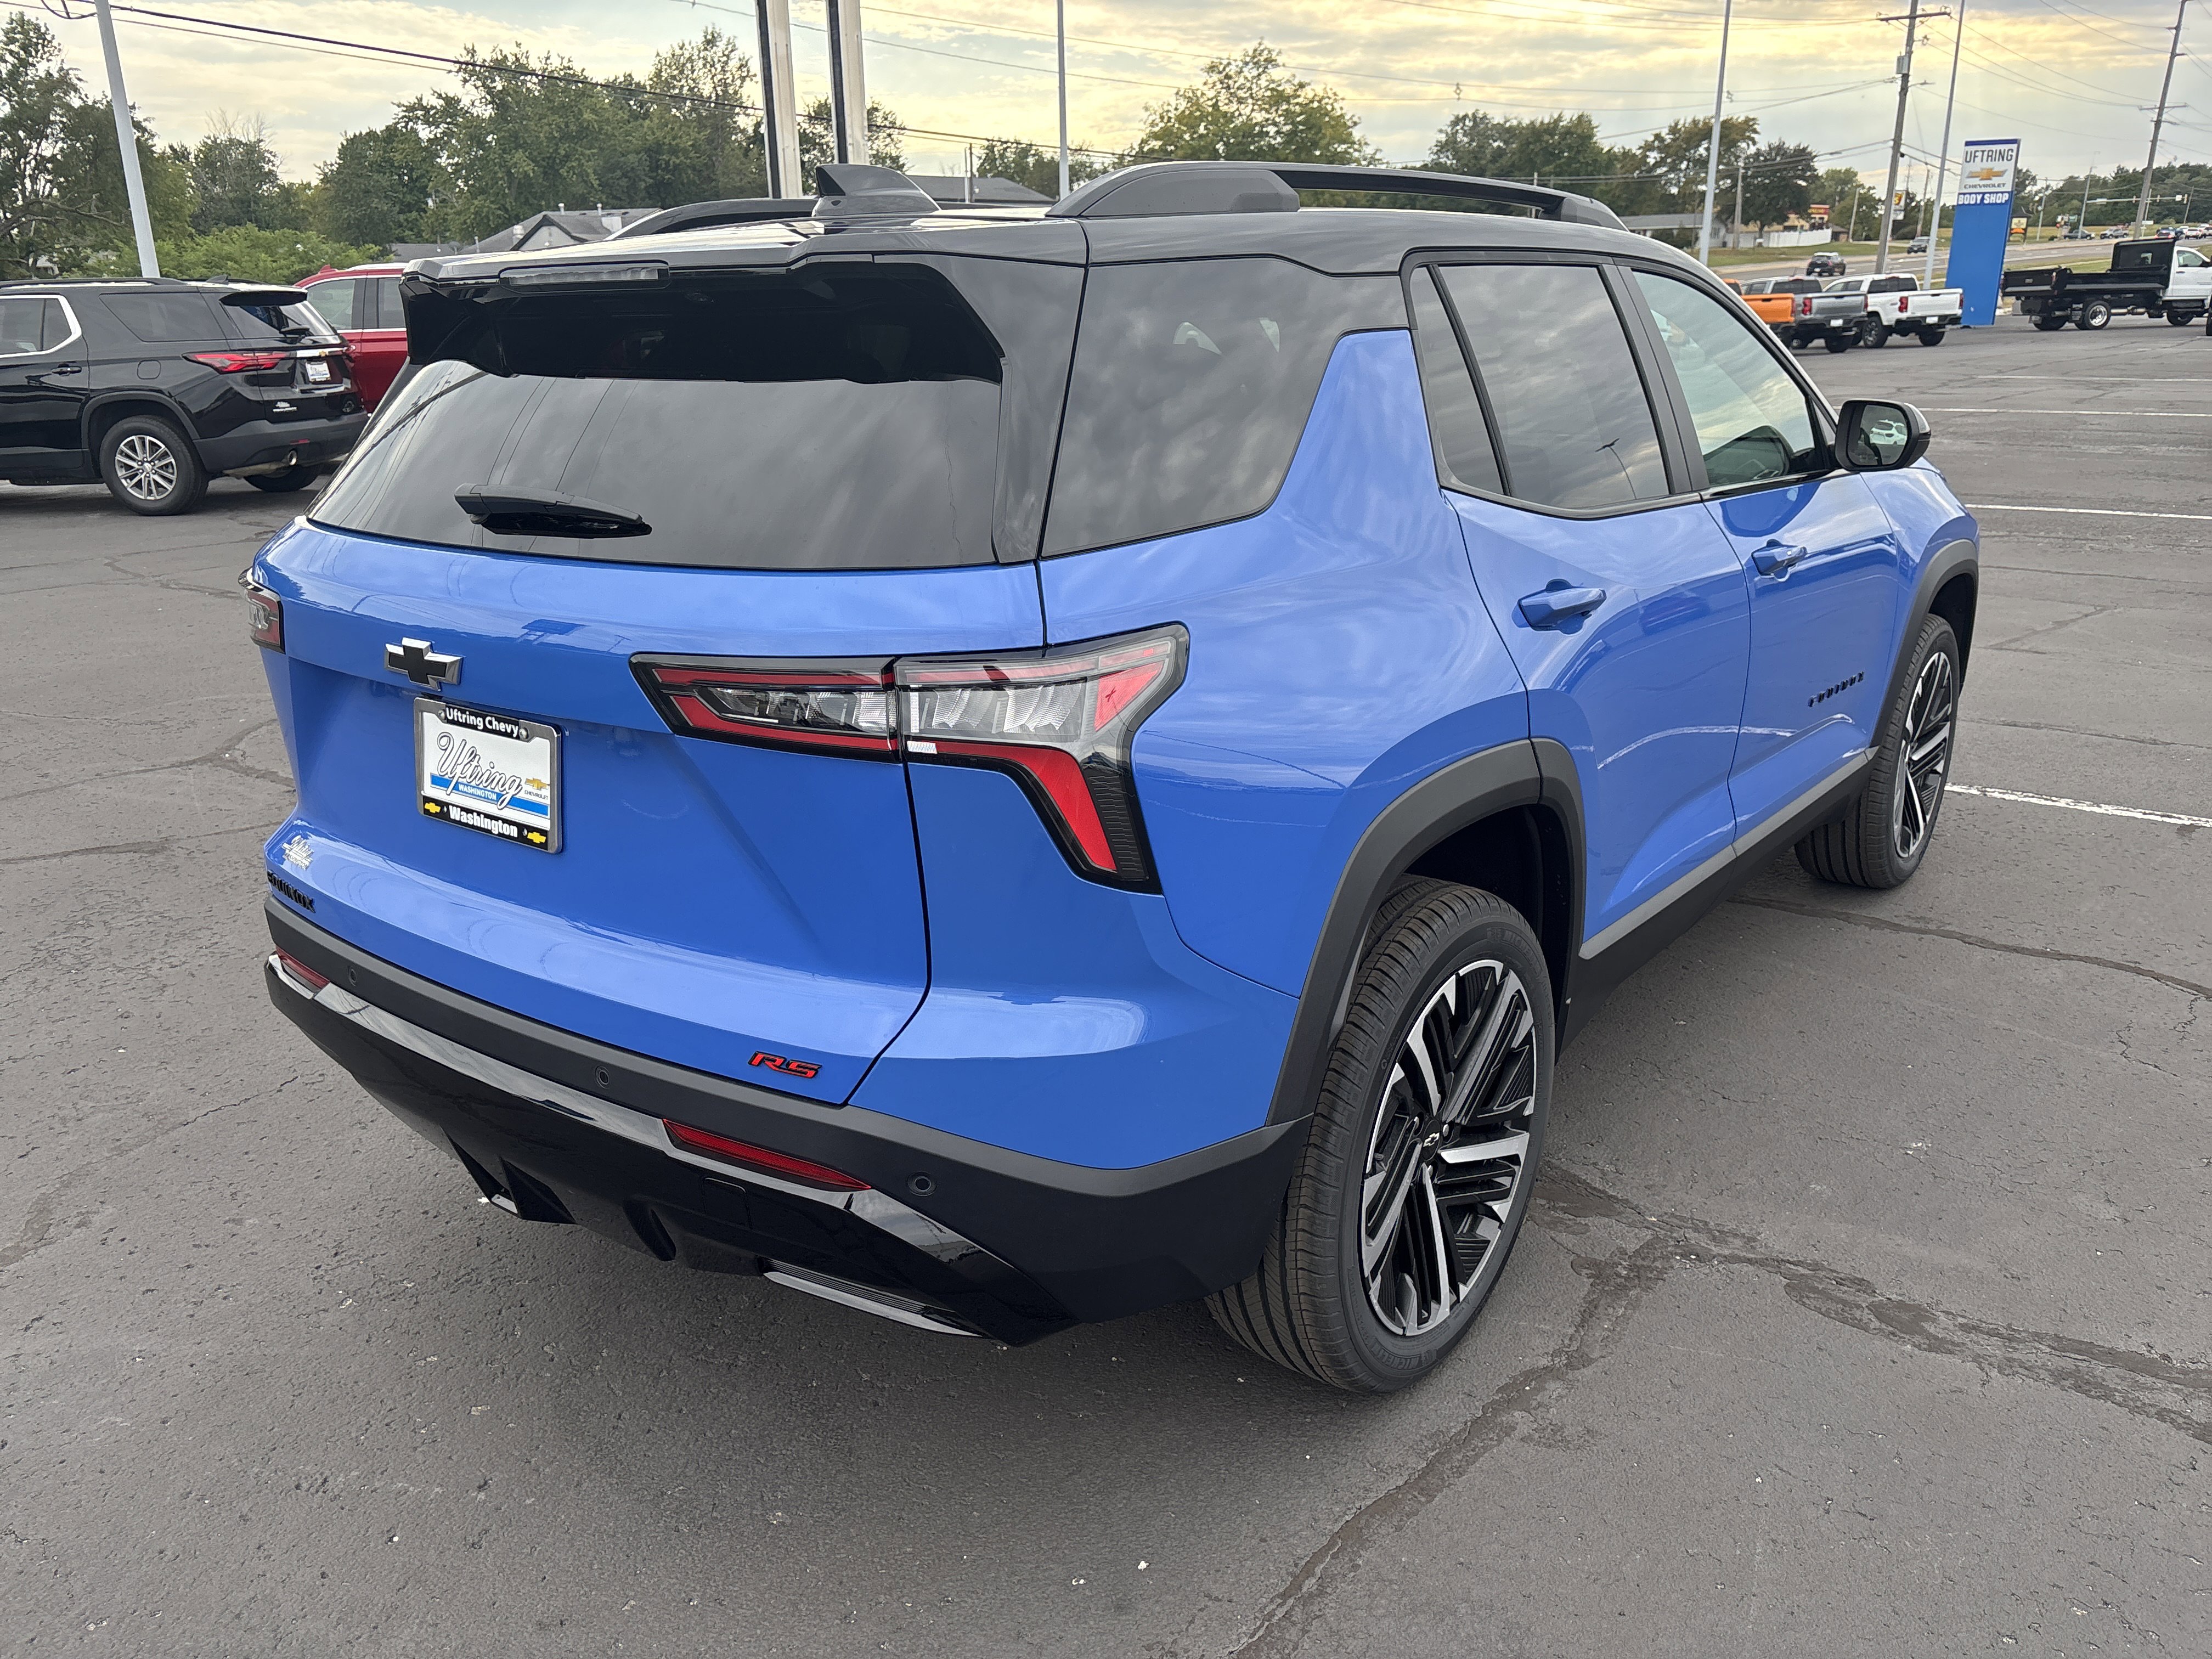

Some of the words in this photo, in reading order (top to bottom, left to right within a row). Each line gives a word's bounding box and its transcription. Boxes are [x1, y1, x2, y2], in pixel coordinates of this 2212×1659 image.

[1965, 149, 2013, 163] UFTRING
[1958, 194, 1982, 205] BODY
[1984, 193, 2009, 204] SHOP
[445, 707, 484, 730] Uftring
[485, 716, 519, 738] Chevy
[437, 732, 523, 810] Uftring
[459, 785, 496, 800] WASHINGTON
[524, 789, 549, 800] CHEVROLET
[449, 805, 518, 838] Washington
[747, 1050, 823, 1079] RS
